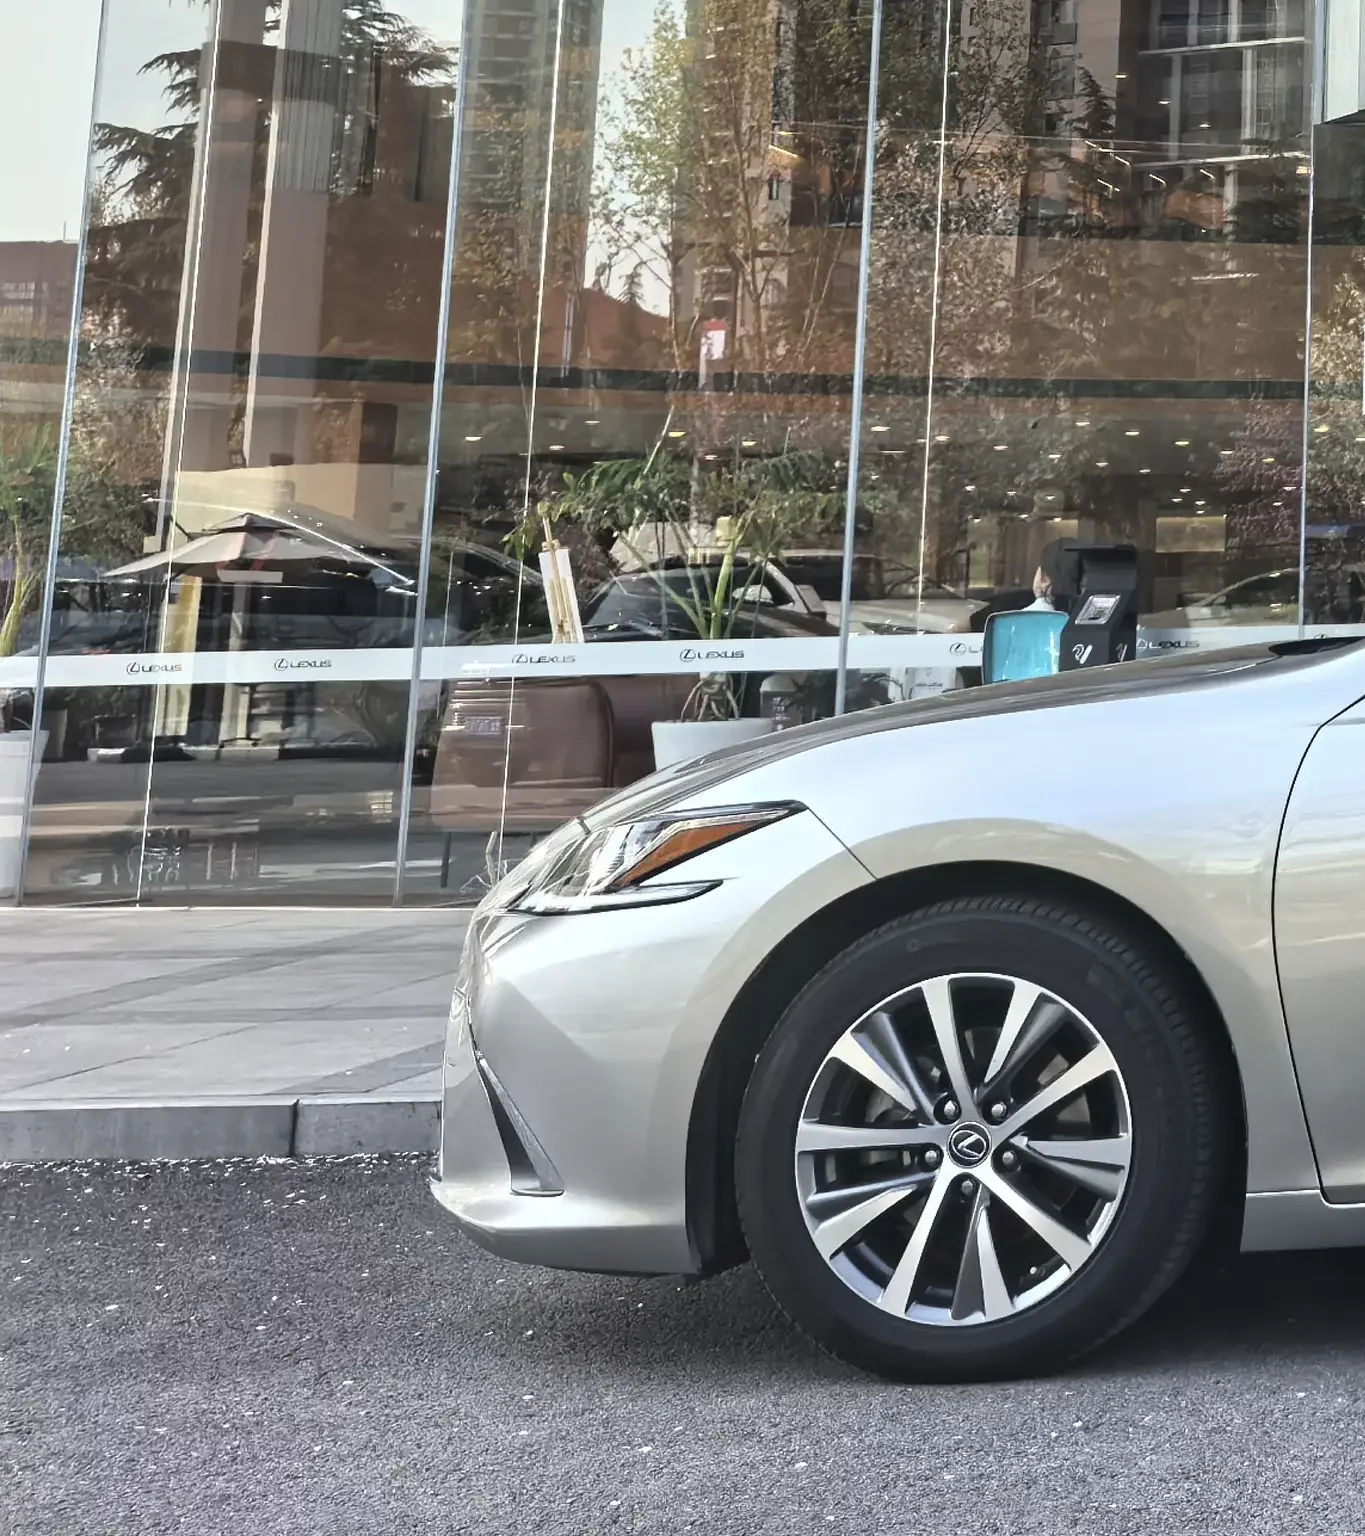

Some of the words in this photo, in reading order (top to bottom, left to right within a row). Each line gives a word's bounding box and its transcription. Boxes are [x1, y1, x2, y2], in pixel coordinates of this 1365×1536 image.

[1148, 640, 1201, 650] LEXUS
[529, 654, 577, 664] LEXUS
[697, 649, 745, 660] LEXUS
[141, 663, 183, 673] LEXUS
[289, 659, 333, 668] LEXUS
